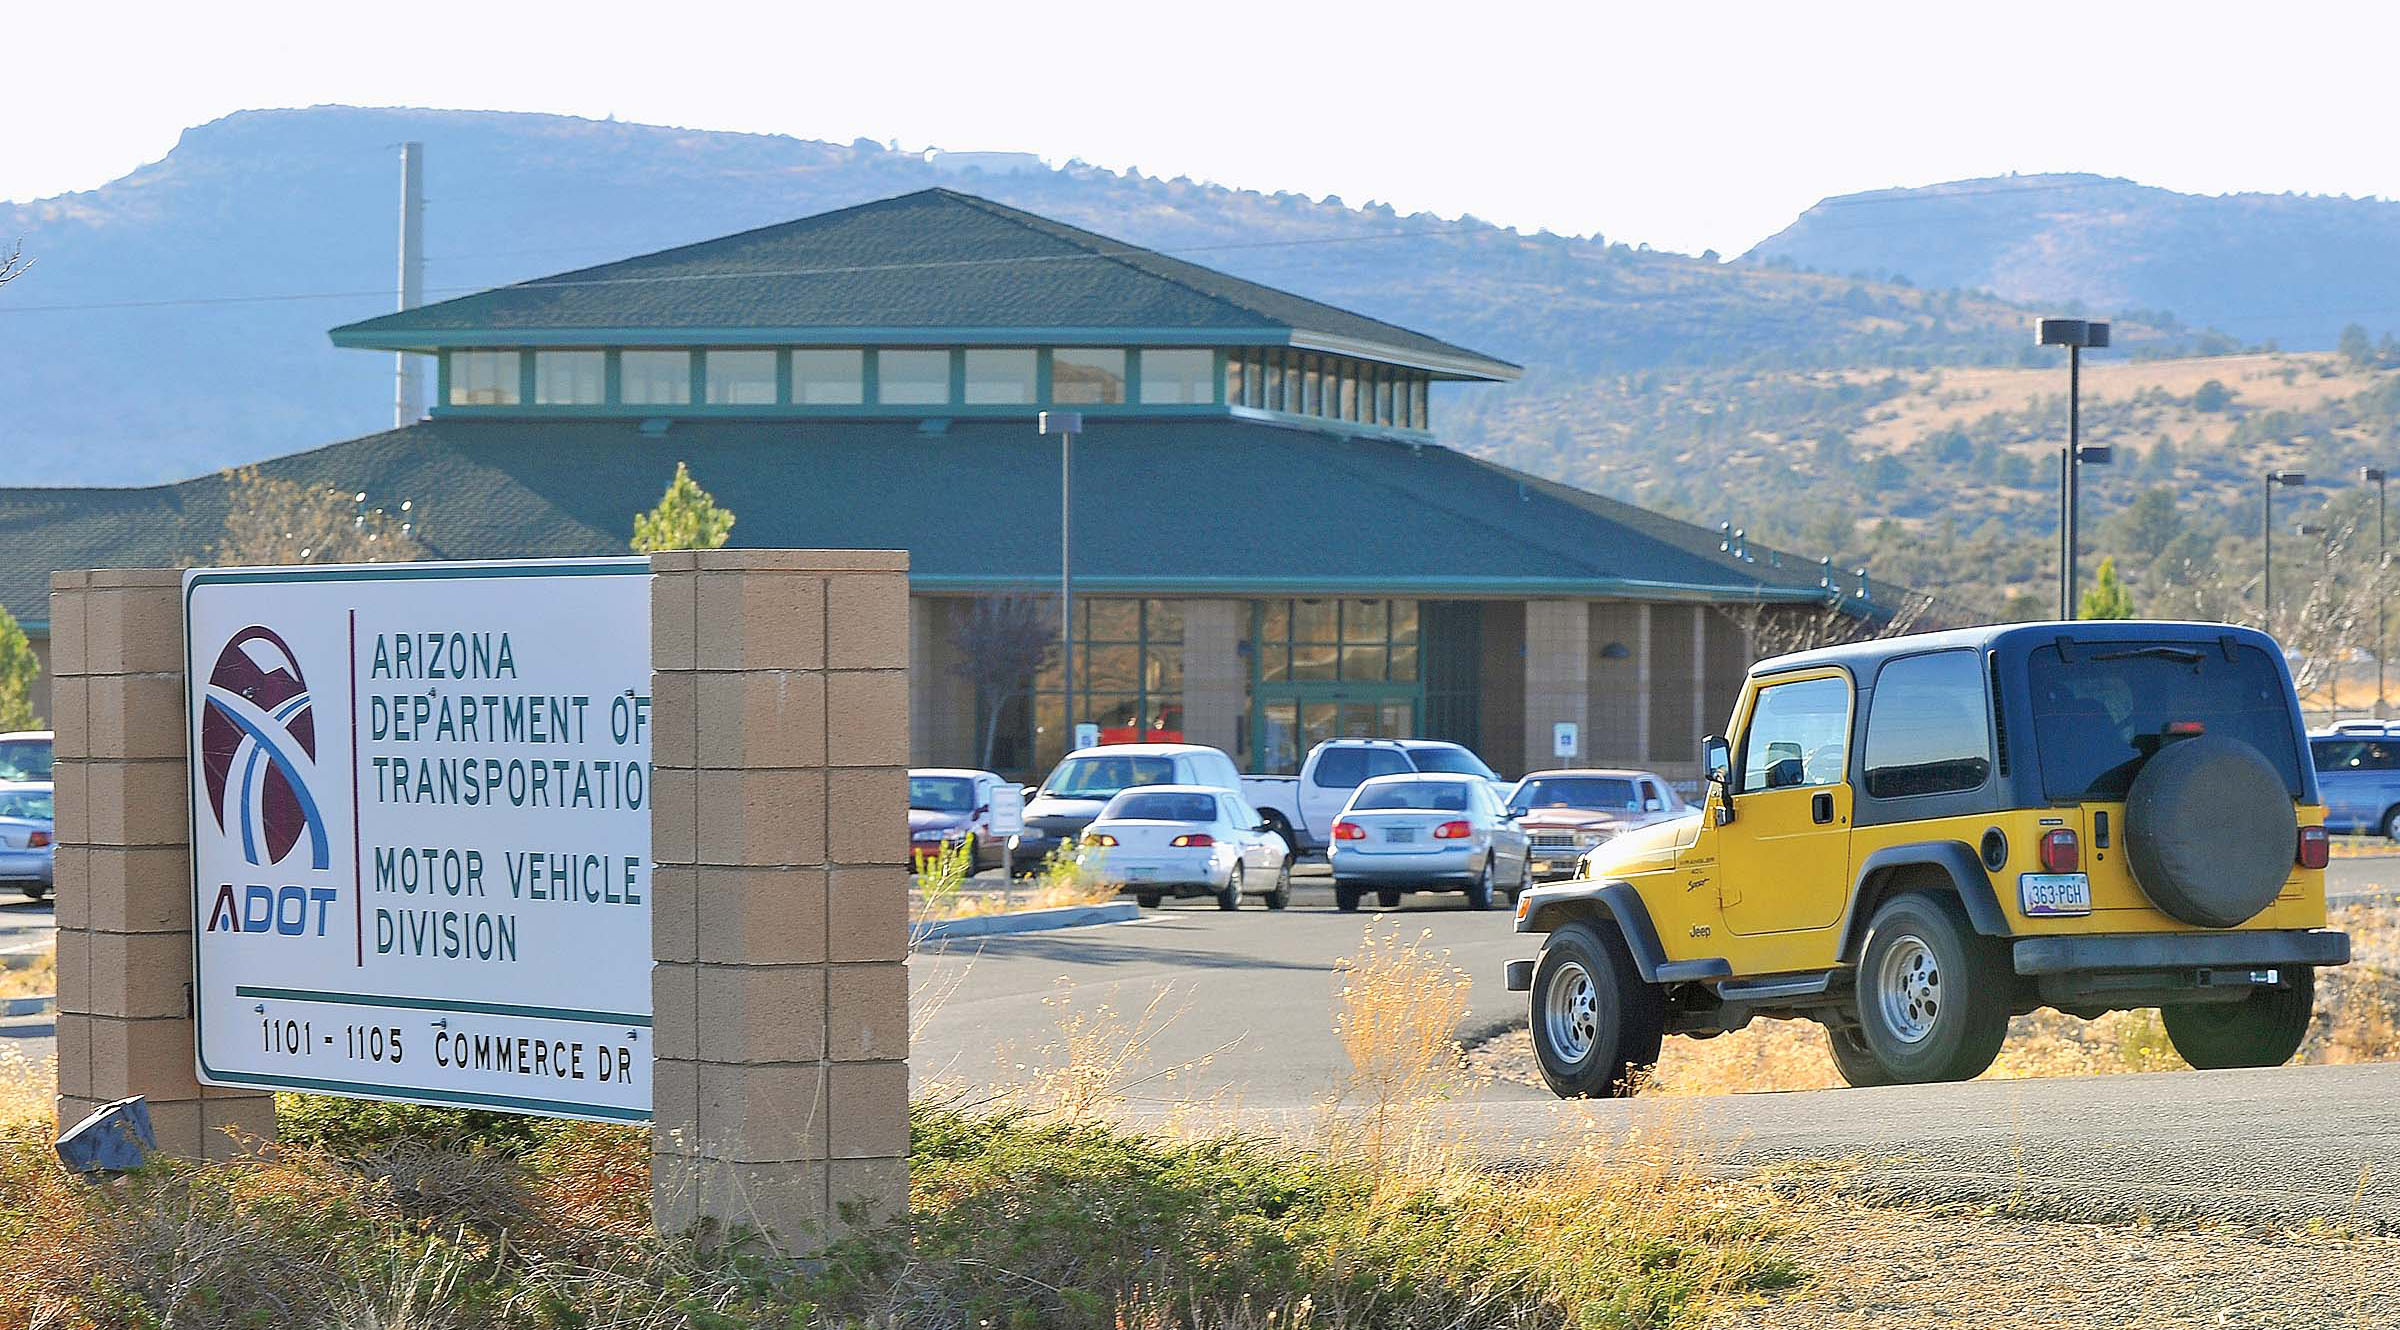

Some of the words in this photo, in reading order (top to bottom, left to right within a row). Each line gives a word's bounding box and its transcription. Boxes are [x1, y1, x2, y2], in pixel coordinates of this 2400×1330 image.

[372, 633, 517, 679] ARIZONA
[372, 695, 589, 743] DEPARTMENT
[612, 696, 652, 745] OF
[373, 757, 651, 810] TRANSPORTATIO
[375, 847, 485, 896] MOTOR
[505, 852, 640, 904] VEHICLE
[206, 885, 336, 936] ADOT
[376, 909, 516, 961] DIVISION
[1689, 925, 1711, 938] Jeep
[263, 1018, 311, 1055] 1101
[347, 1025, 403, 1064] 1105
[435, 1032, 585, 1080] COMMERCE
[598, 1045, 632, 1085] DR
